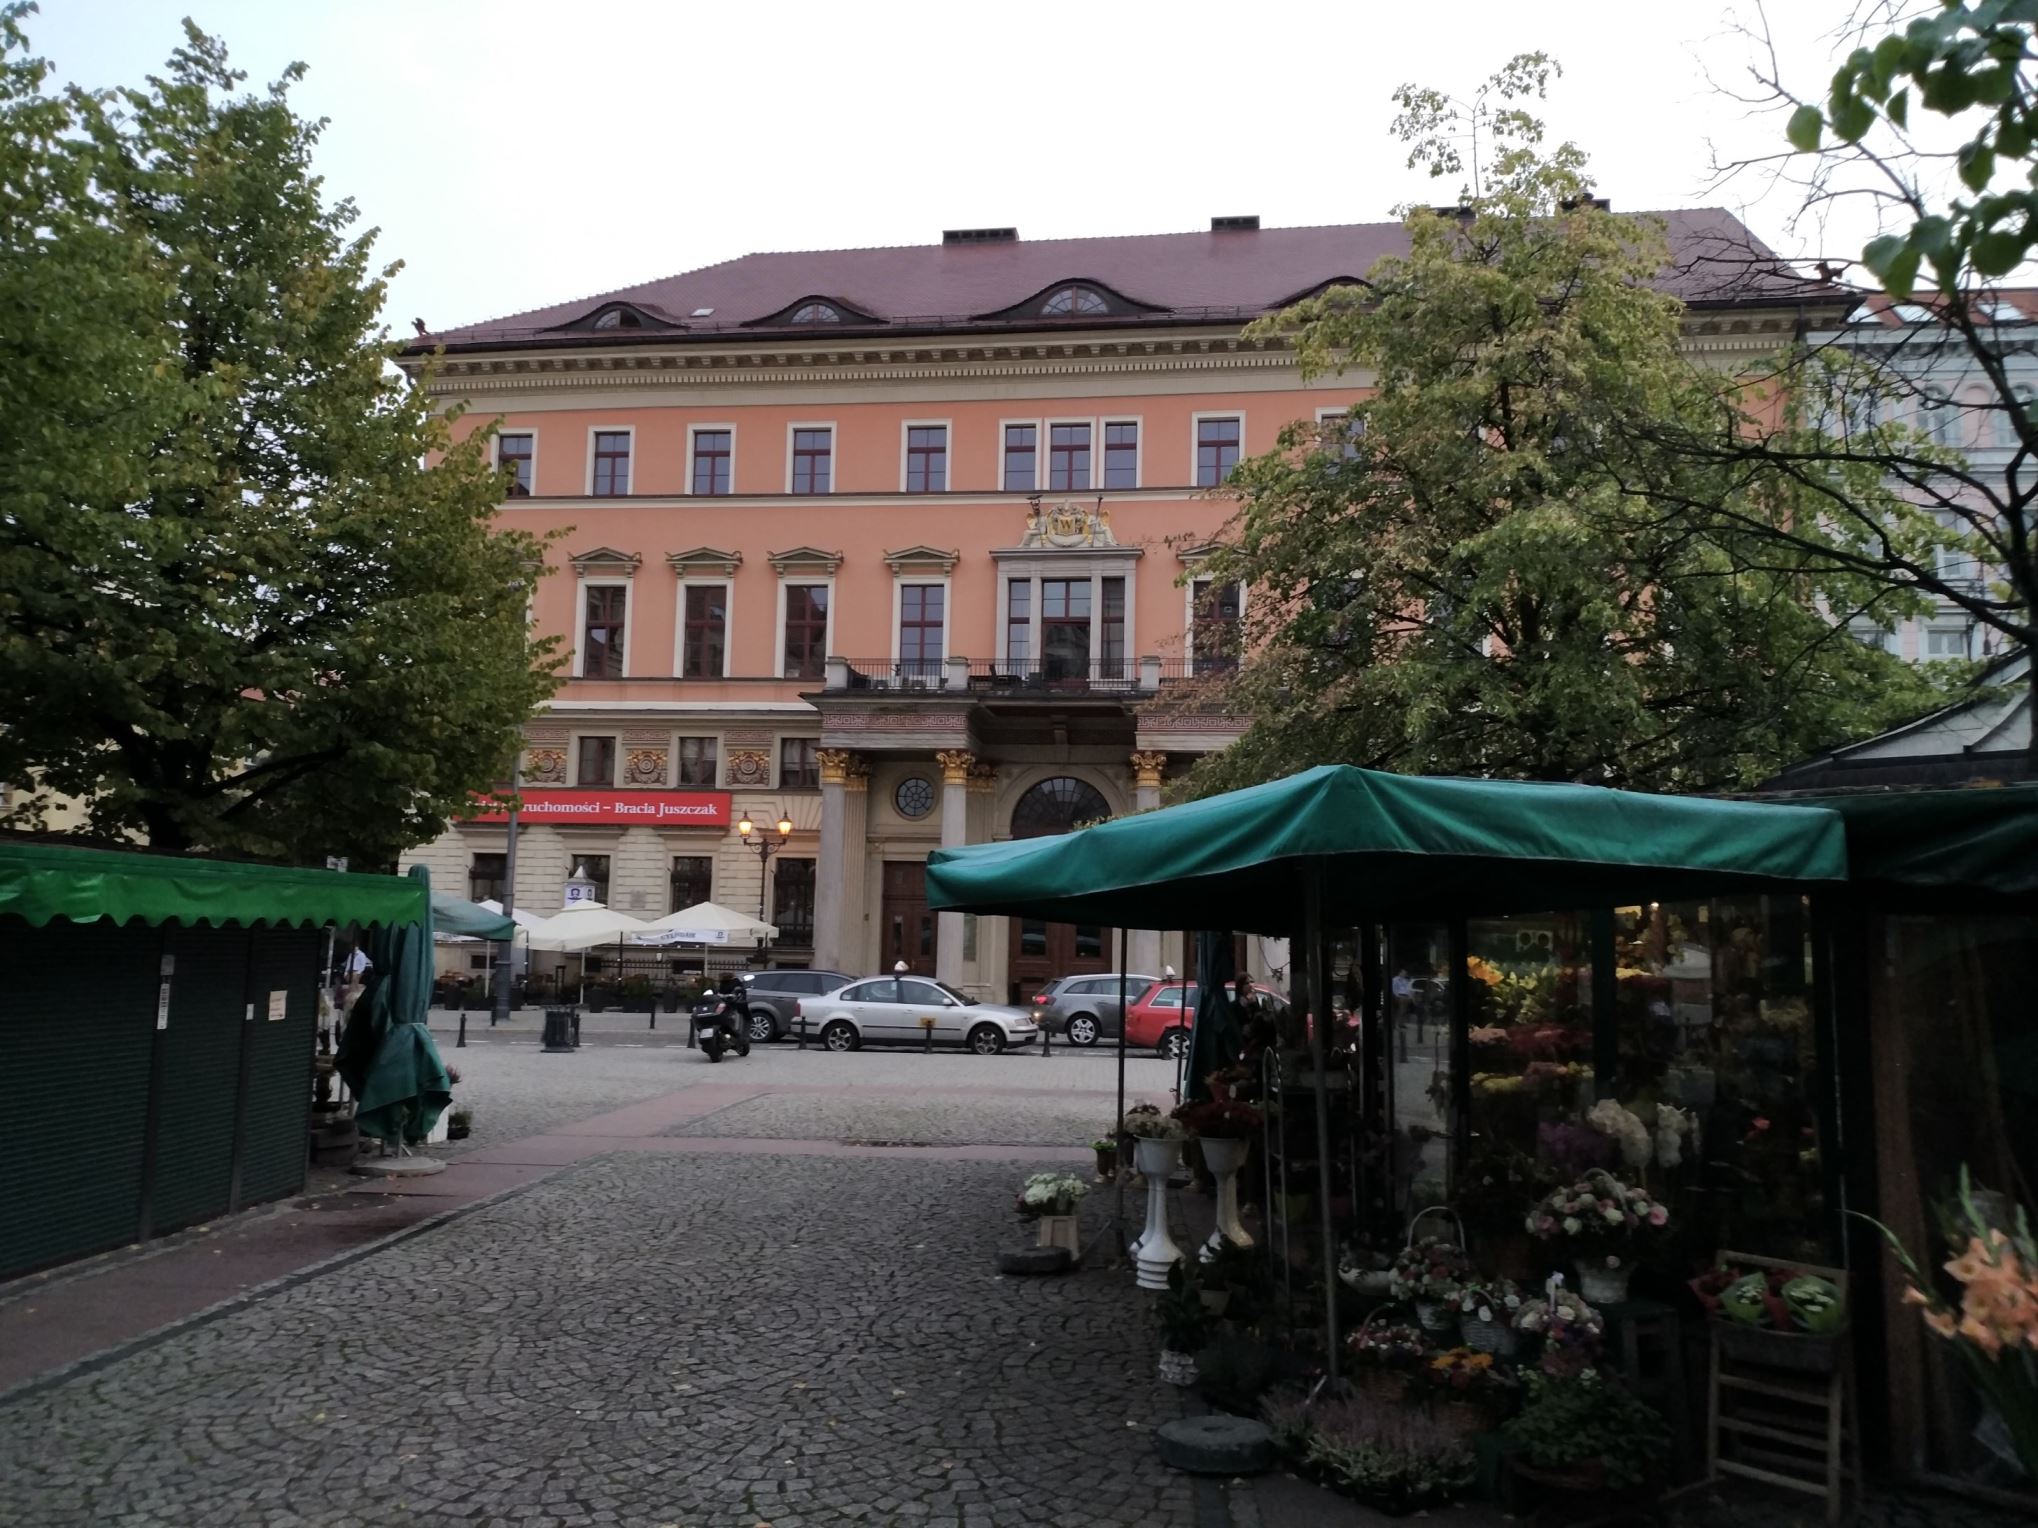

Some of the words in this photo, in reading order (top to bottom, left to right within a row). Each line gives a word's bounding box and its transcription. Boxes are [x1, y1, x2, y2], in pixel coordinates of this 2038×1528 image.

[504, 801, 600, 813] ruchomości
[615, 802, 655, 814] Bracia
[657, 803, 718, 817] Juszczak
